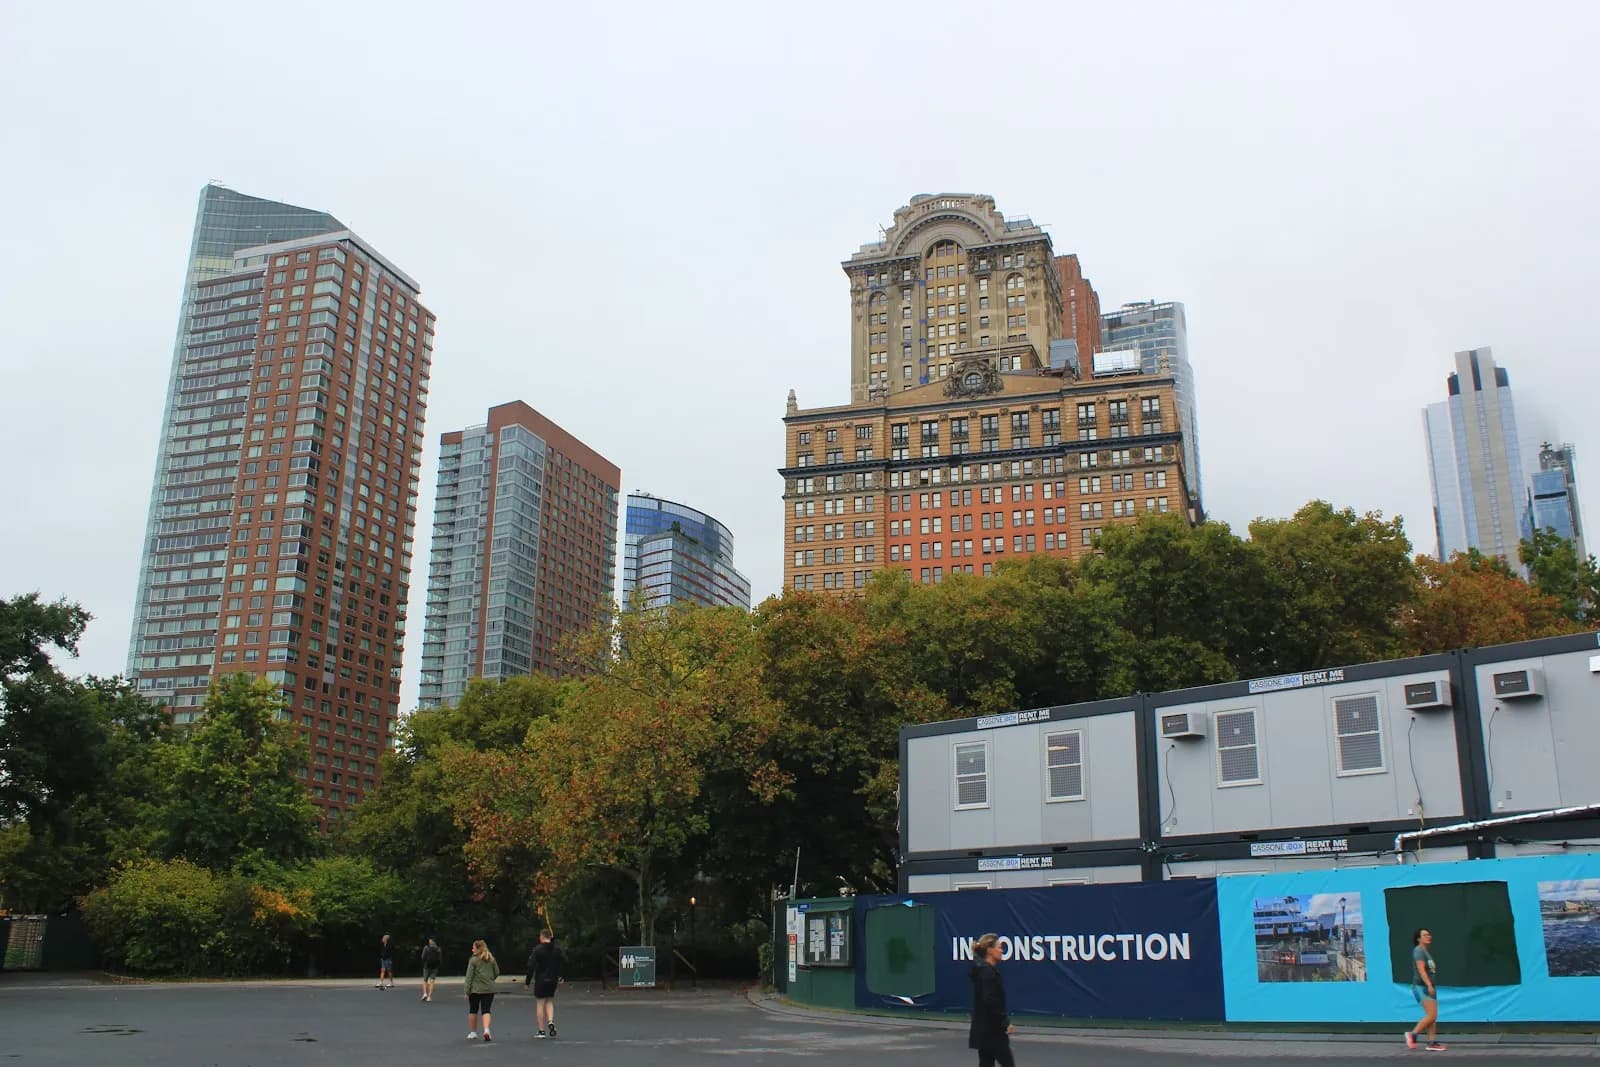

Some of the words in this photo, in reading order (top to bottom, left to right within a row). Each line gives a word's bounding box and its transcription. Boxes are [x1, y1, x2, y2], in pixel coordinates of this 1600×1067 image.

[1304, 671, 1328, 681] RENT
[1329, 669, 1344, 677] ME
[1019, 711, 1039, 720] RENT
[1039, 709, 1050, 717] ME
[1306, 840, 1331, 848] RENT
[952, 936, 974, 961] IN
[998, 932, 1191, 961] ONSTRUCTION
